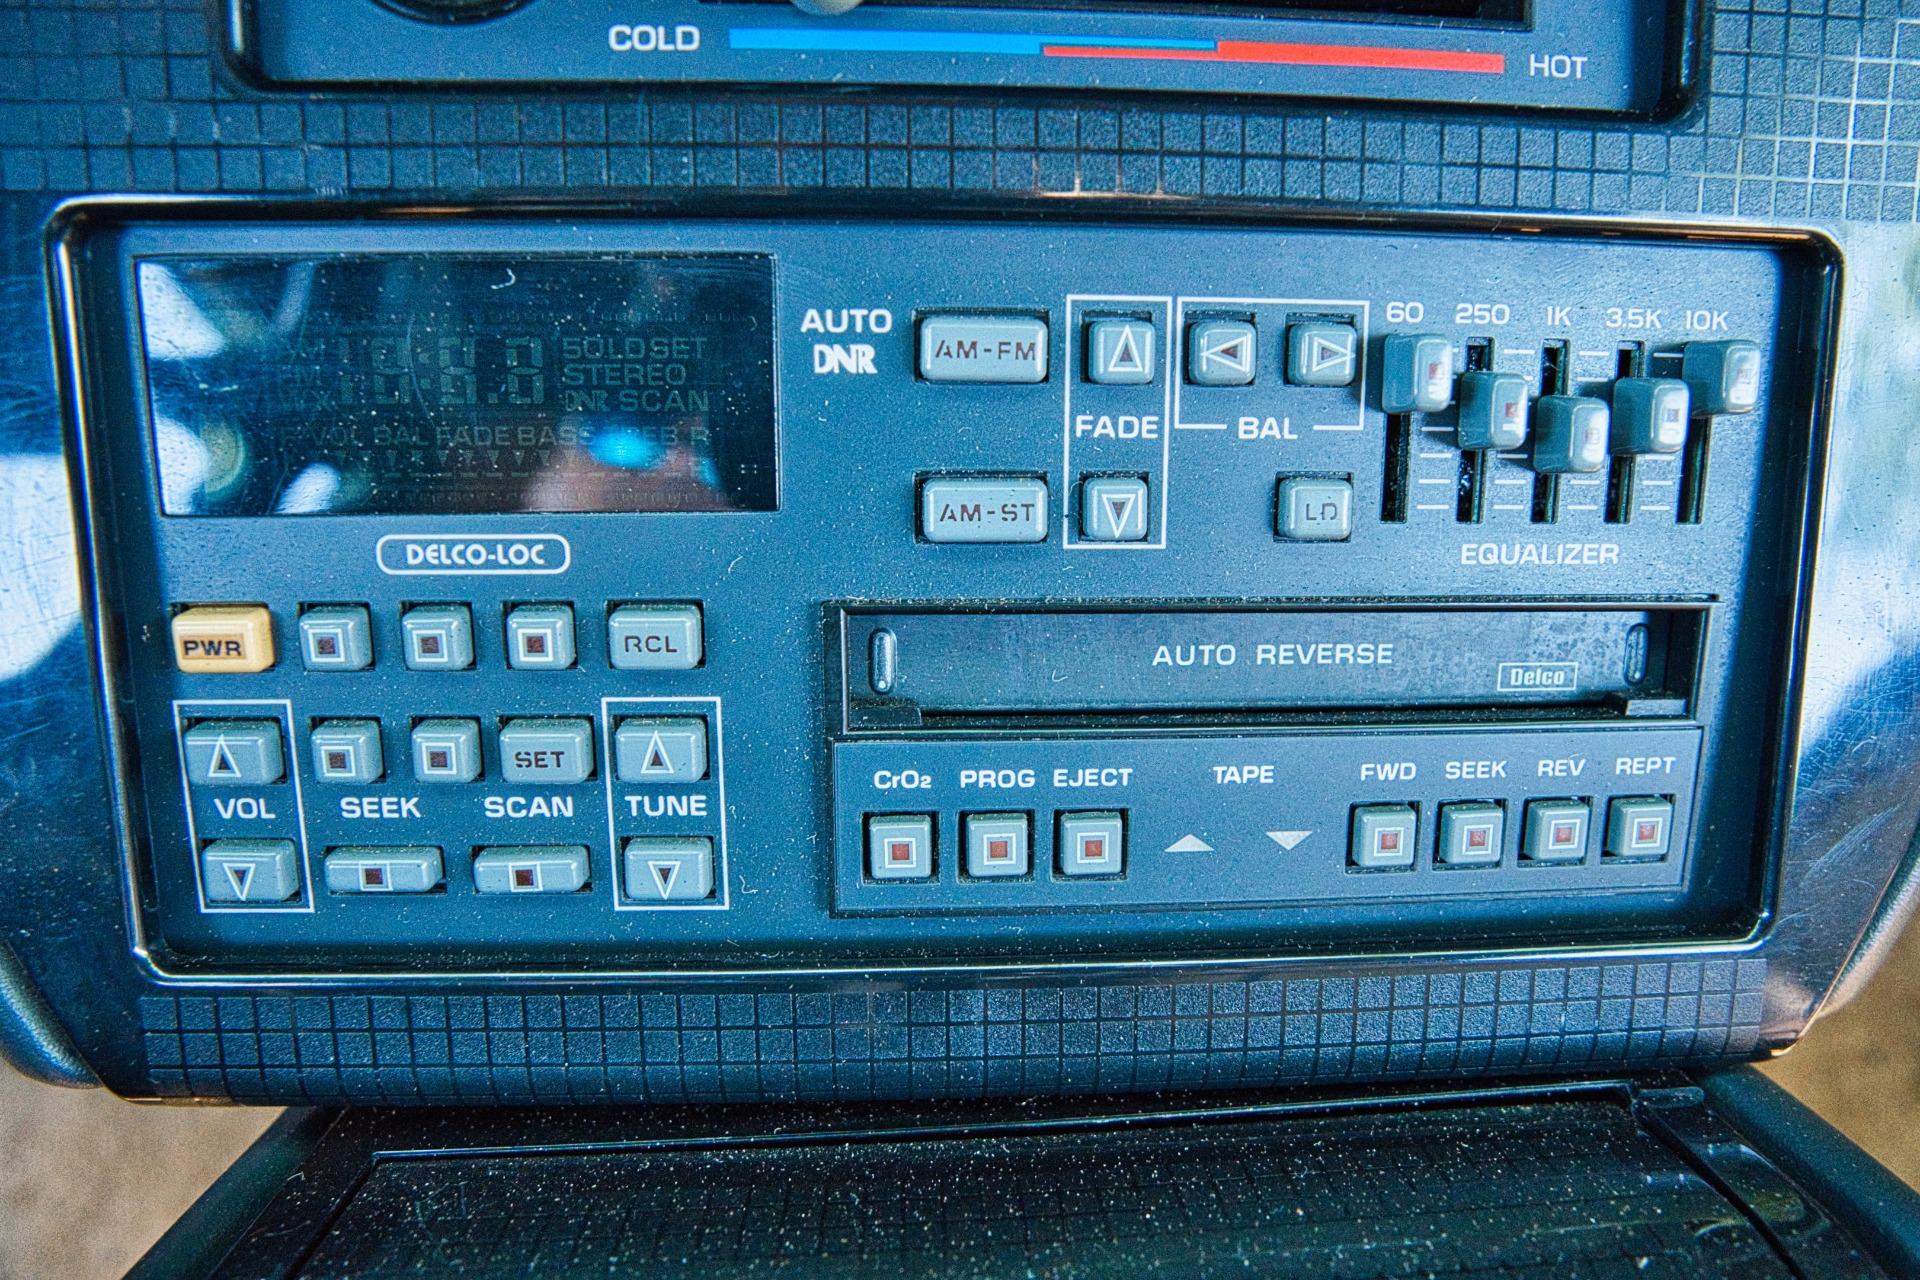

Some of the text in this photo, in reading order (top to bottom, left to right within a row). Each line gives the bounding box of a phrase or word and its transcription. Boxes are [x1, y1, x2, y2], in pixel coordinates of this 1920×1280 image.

[608, 24, 700, 51] COLD
[1529, 53, 1588, 79] HOT
[800, 308, 892, 333] AUTO
[1385, 301, 1729, 331] 60 250 1K 3.5K 10K
[813, 344, 877, 374] DNR
[935, 339, 1038, 361] AM-FM
[563, 363, 687, 386] STEREO
[619, 389, 710, 412] SCAN
[374, 427, 428, 446] BAL
[436, 426, 512, 447] FADE
[517, 426, 597, 446] BASS
[1075, 415, 1160, 439] FADE
[1237, 416, 1299, 440] BAL
[939, 502, 1036, 524] AM-ST
[405, 543, 545, 566] DELCO-LOC
[1460, 543, 1621, 566] EQUALIZER
[183, 639, 244, 657] PWR
[624, 634, 678, 653] RCL
[1151, 643, 1395, 667] AUTO REVERSE
[1509, 668, 1566, 687] Delco
[513, 750, 566, 769] SET
[1444, 760, 1508, 780] SEEK
[1537, 758, 1587, 778] REV
[1614, 756, 1677, 776] REPT
[959, 768, 1036, 789] PROG
[1052, 767, 1134, 789] EJECT
[1213, 764, 1276, 785] TAPE
[1359, 762, 1418, 782] FWD
[213, 797, 277, 820] VOL
[339, 796, 422, 820] SEEK
[483, 795, 575, 819] SCAN
[623, 794, 708, 818] TUNE
